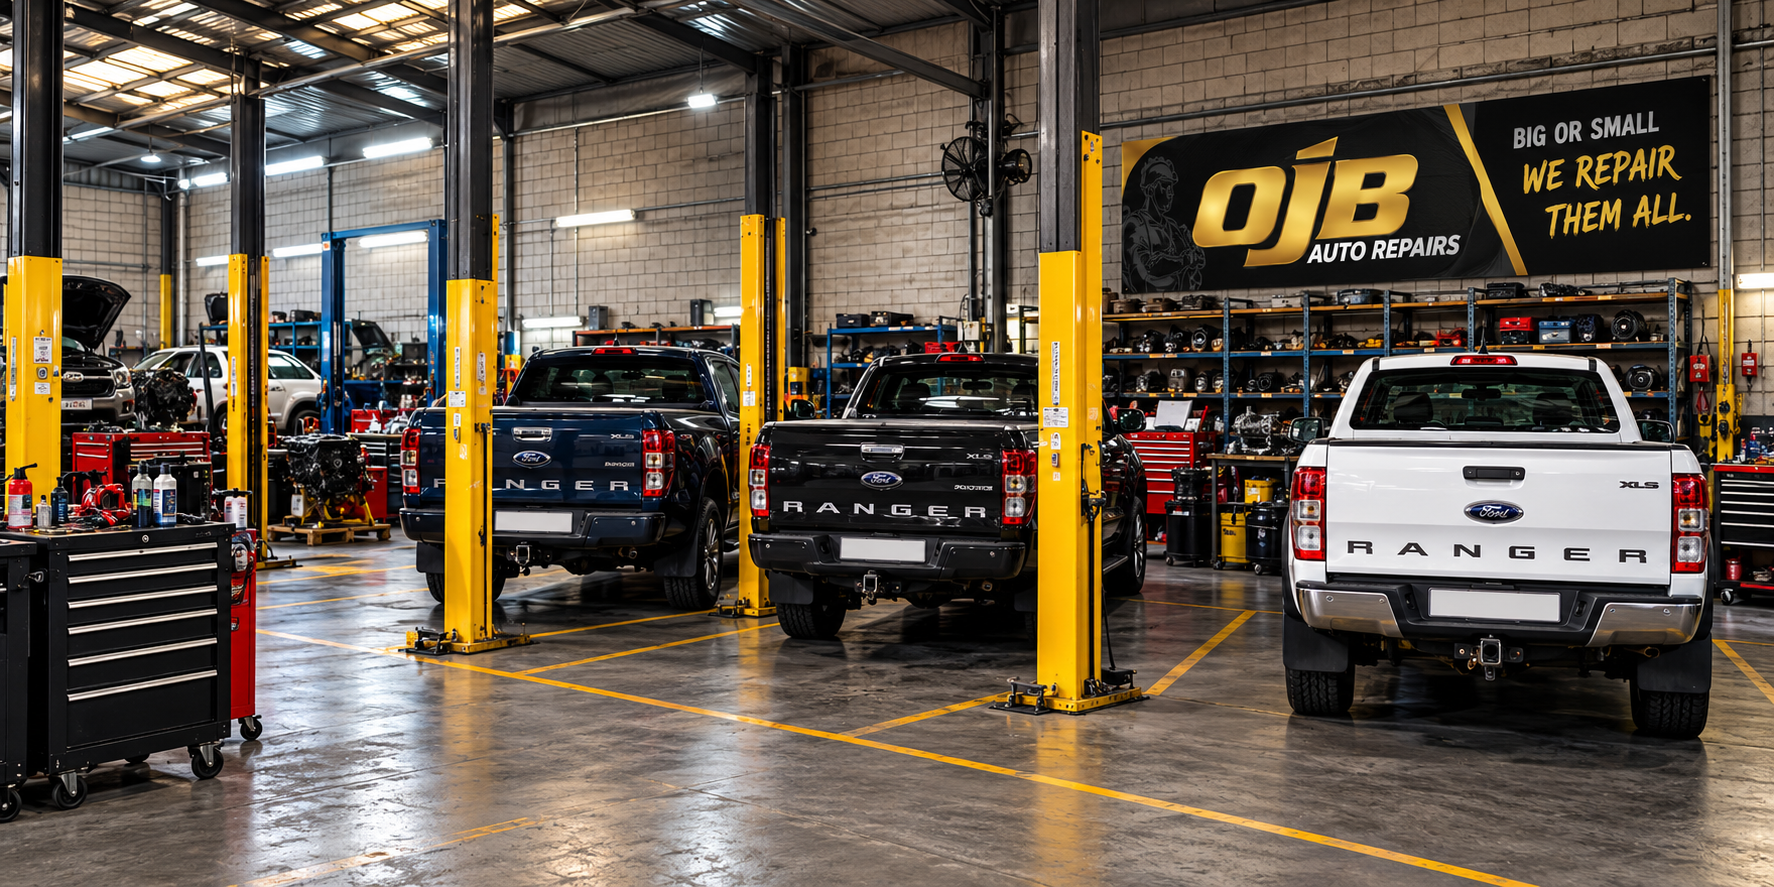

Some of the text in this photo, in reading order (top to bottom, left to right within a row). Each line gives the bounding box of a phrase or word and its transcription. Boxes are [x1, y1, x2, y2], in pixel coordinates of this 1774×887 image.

[1513, 111, 1660, 149] BIG OR SMALL
[1523, 145, 1682, 194] WE REPAIR
[1545, 192, 1692, 239] THEM ALL.
[1307, 234, 1461, 263] AUTO REPAIRS
[433, 478, 629, 492] RNGER
[1619, 480, 1659, 489] XLS
[783, 500, 986, 518] RANGER
[1479, 504, 1510, 518] Ford
[1347, 540, 1647, 563] RANGER
